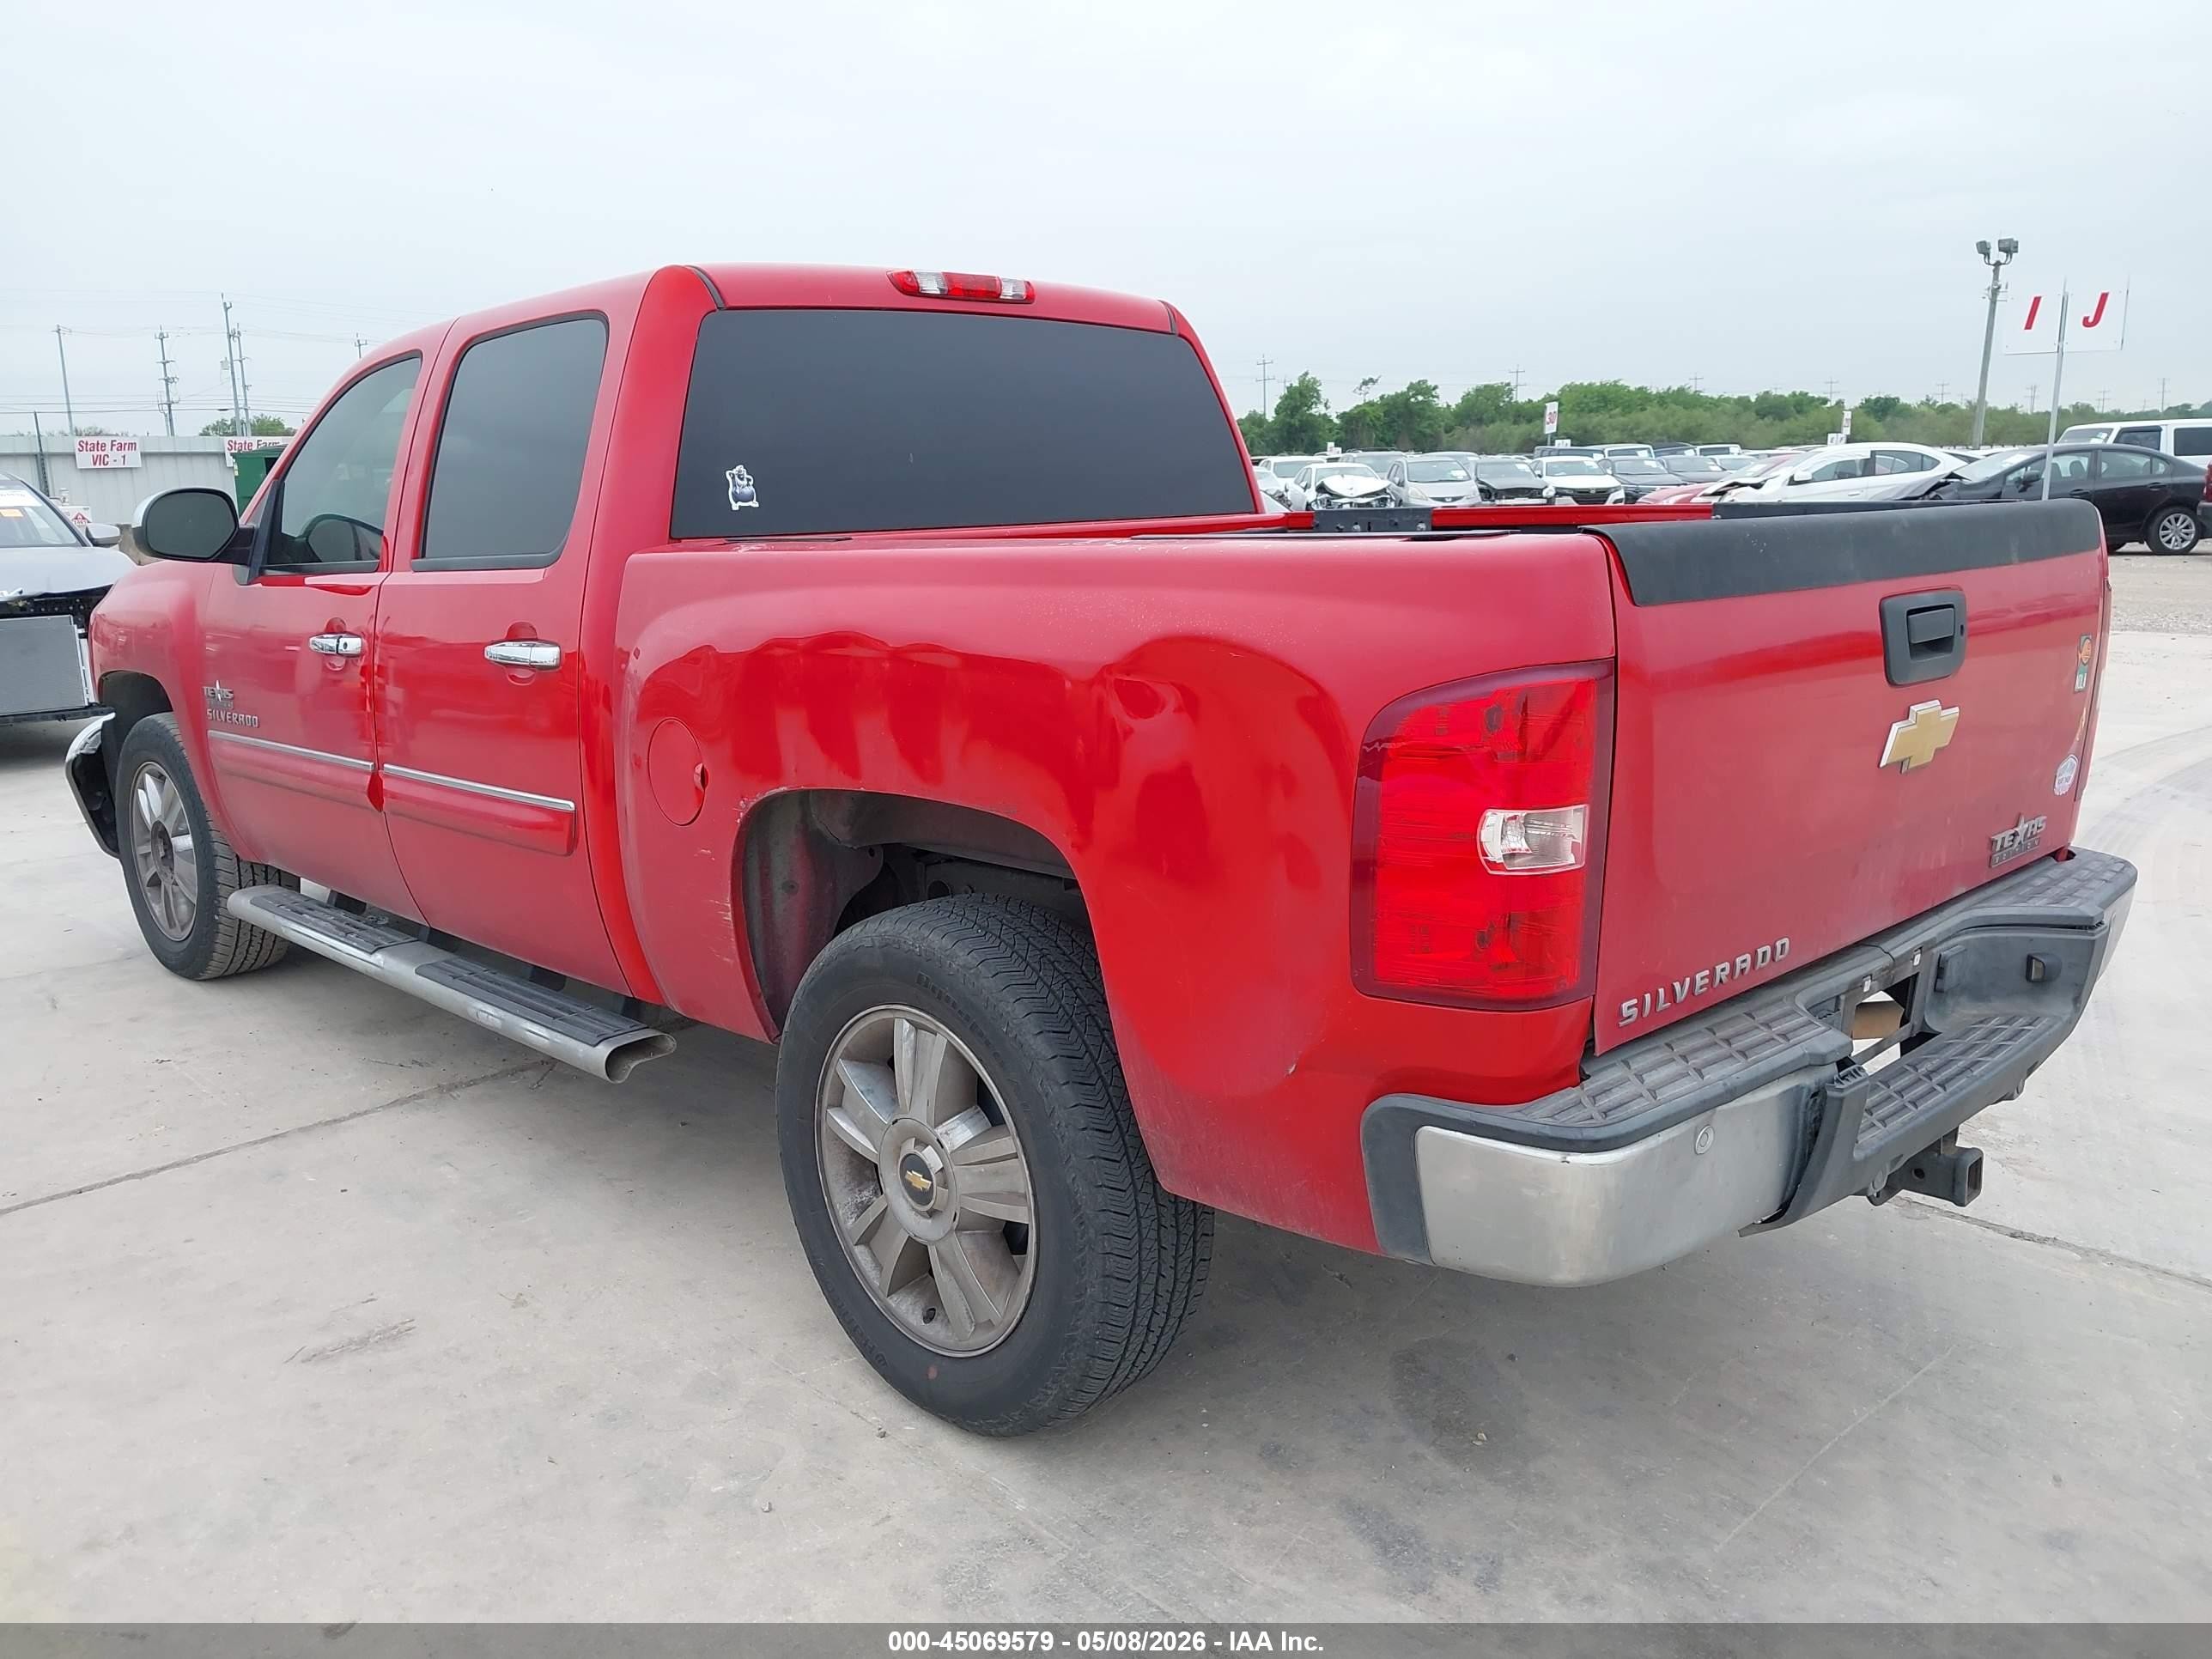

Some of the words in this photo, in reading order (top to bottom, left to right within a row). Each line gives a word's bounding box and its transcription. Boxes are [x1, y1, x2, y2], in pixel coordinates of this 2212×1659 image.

[2082, 292, 2109, 328] J
[77, 440, 106, 452] State
[110, 440, 137, 452] Farm
[227, 439, 253, 452] State
[92, 454, 110, 466] VIC
[121, 454, 126, 465] 1
[206, 708, 259, 728] SILVERADO
[1990, 815, 2047, 851] TEXAS
[1619, 937, 1790, 1027] SILVERADO
